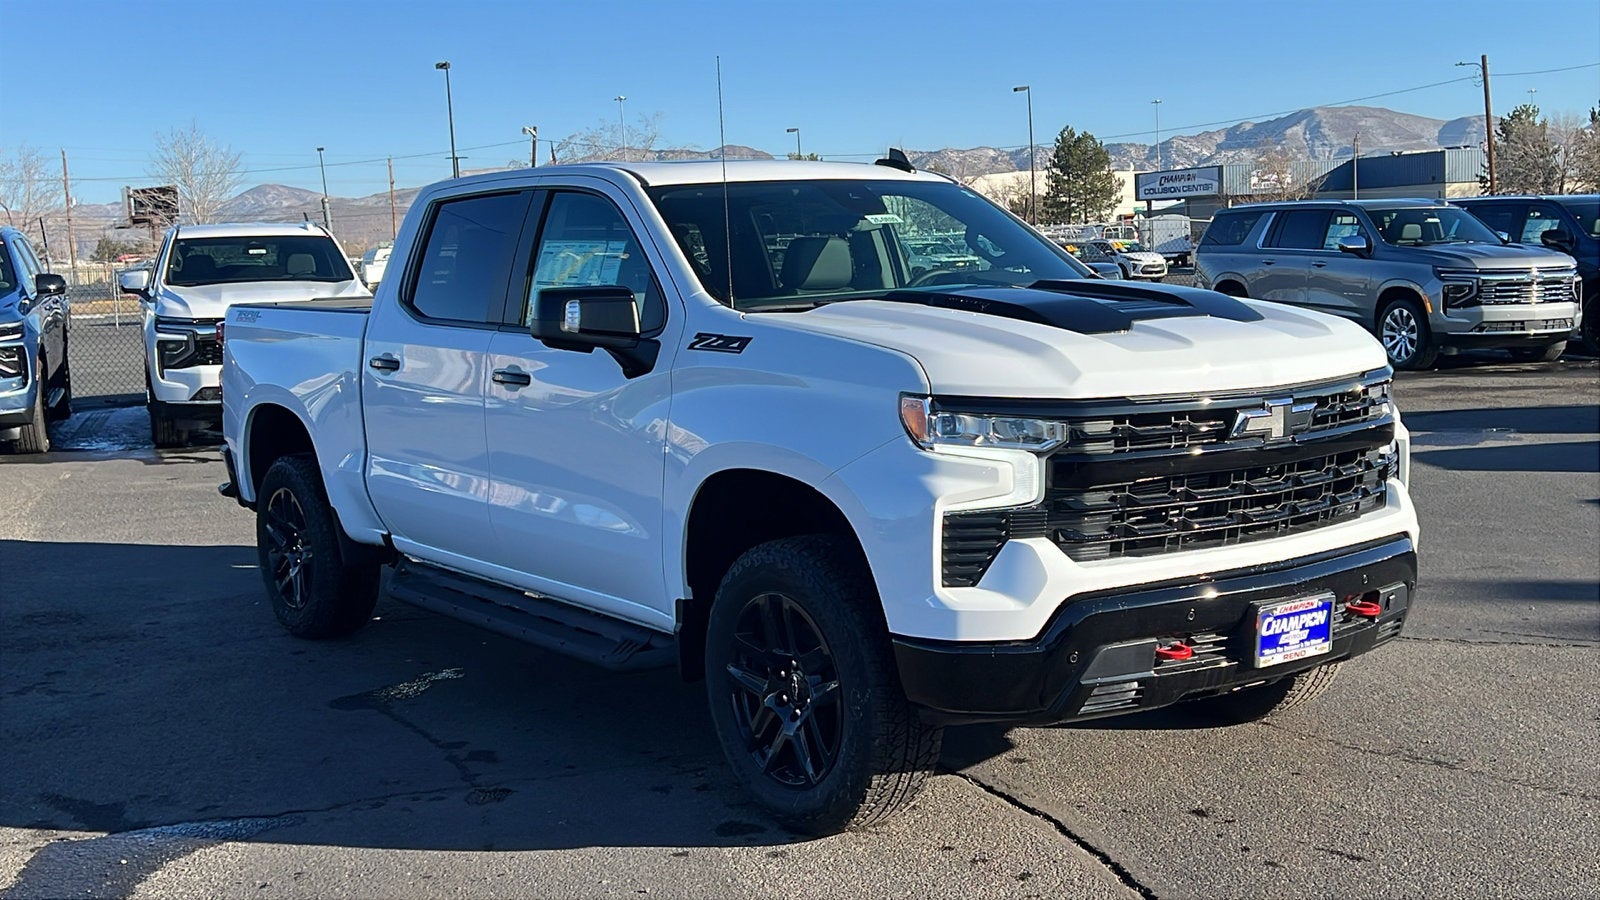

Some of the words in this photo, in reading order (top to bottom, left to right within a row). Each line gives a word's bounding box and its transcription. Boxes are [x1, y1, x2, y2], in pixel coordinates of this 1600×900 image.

[1159, 173, 1197, 187] CHAMPION
[1144, 186, 1181, 195] COLLISION
[1182, 183, 1213, 193] CENTER
[1279, 601, 1315, 613] CHAMPION
[1261, 609, 1328, 636] CHAMPION
[1283, 650, 1306, 660] RENO
